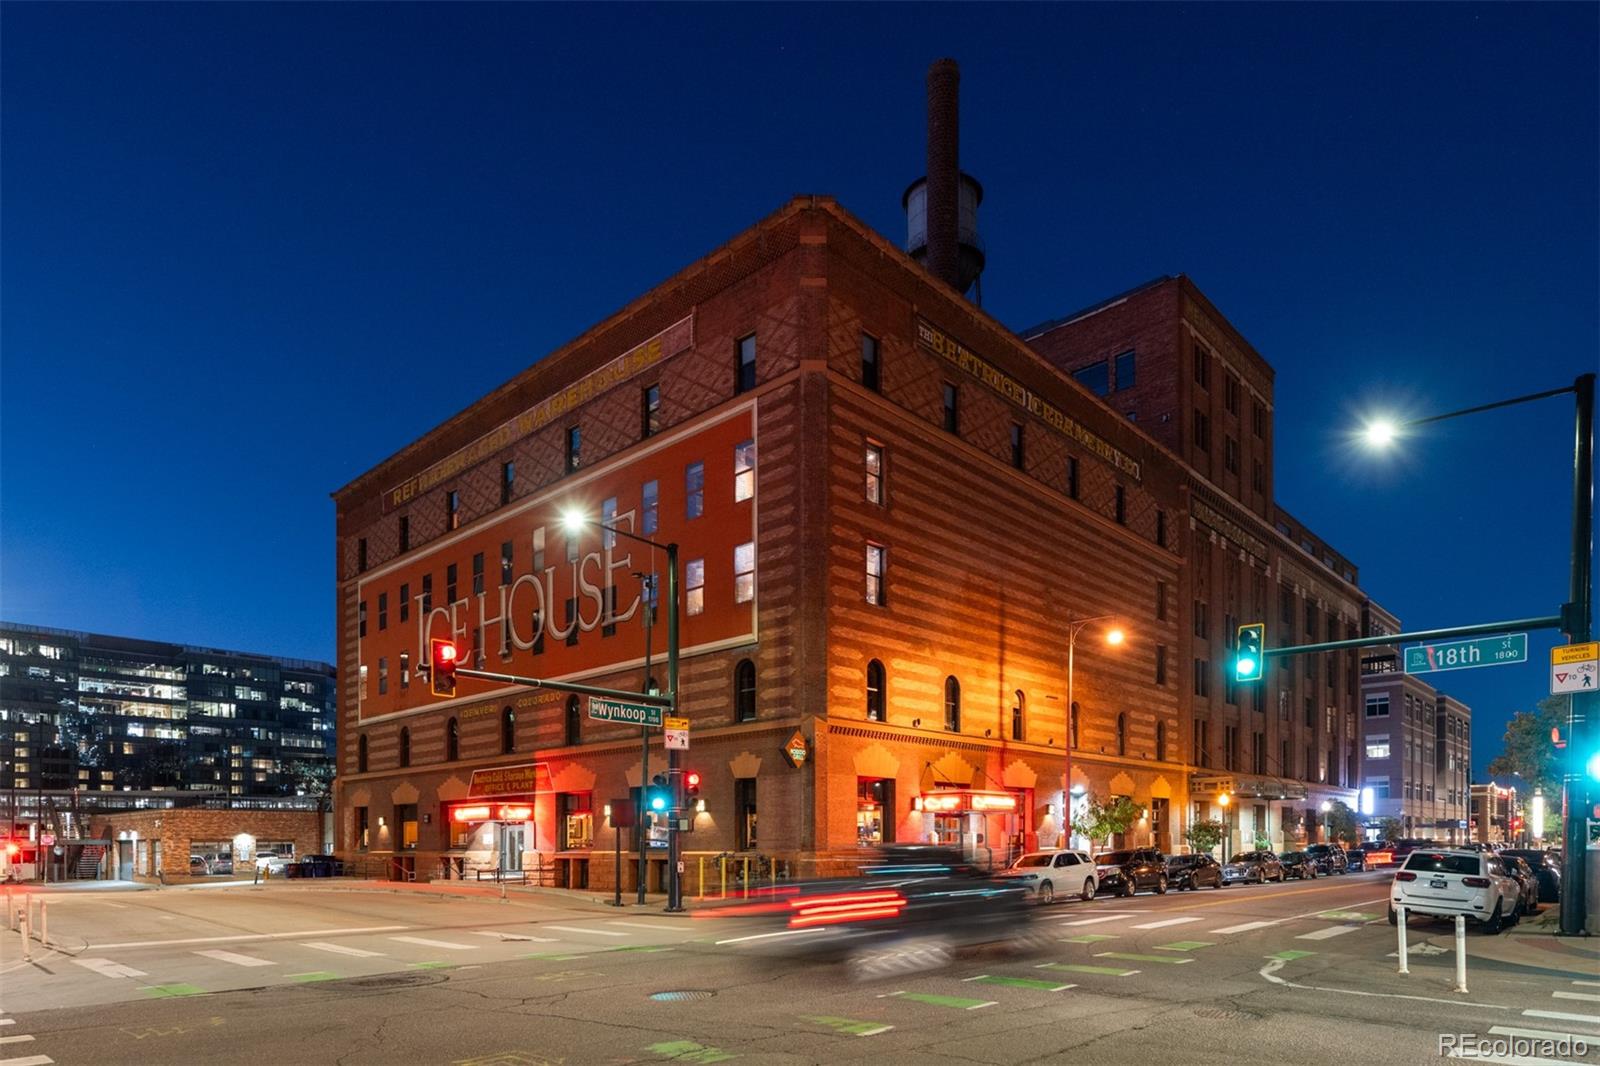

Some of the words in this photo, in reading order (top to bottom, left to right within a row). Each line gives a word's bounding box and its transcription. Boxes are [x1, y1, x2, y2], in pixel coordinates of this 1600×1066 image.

[518, 340, 663, 434] WAREHOUSE
[414, 592, 471, 673] ICE
[477, 509, 641, 662] HOUSE
[1436, 644, 1481, 666] 18th
[1494, 649, 1518, 660] 1800
[1561, 652, 1591, 661] VEHICLES
[1568, 673, 1577, 681] TO
[463, 704, 498, 719] DENVER
[517, 690, 561, 708] COLORADO
[599, 702, 646, 724] Wynkoop
